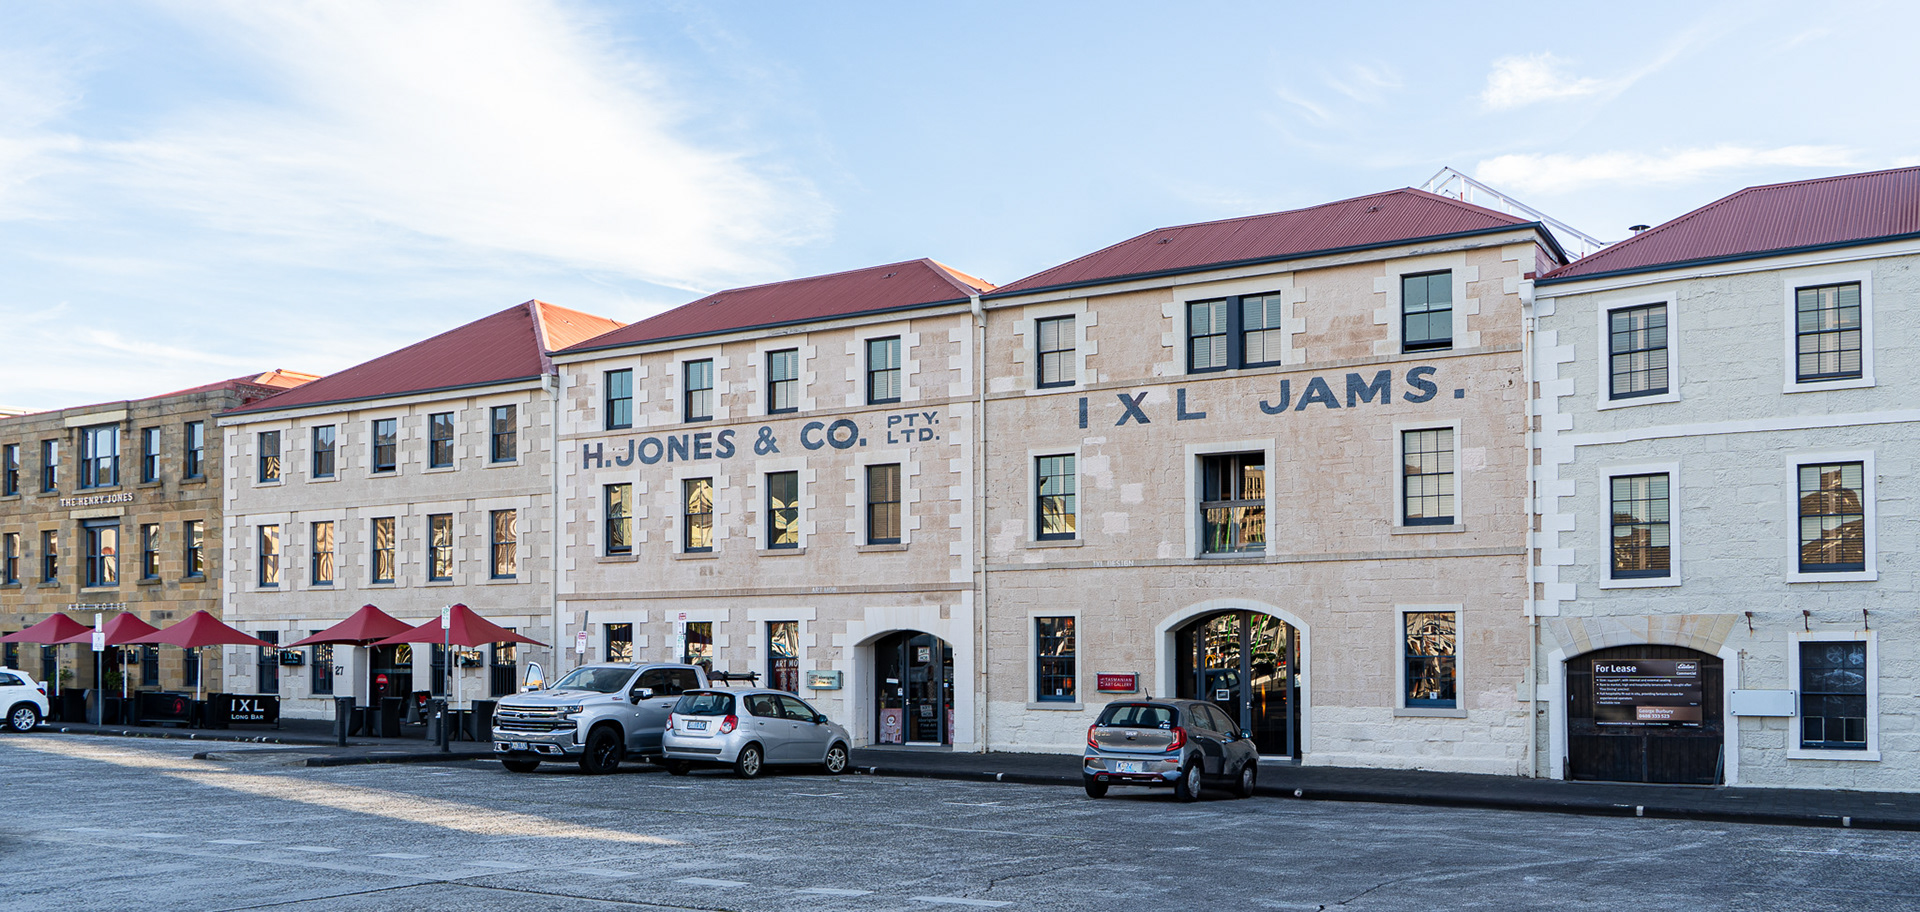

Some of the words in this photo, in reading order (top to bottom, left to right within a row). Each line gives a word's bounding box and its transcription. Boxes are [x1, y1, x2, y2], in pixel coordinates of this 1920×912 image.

[1259, 366, 1465, 414] JAMS.
[888, 411, 939, 429] PTY.
[754, 425, 781, 456] &
[800, 418, 866, 451] CO.
[887, 427, 940, 444] LTD.
[60, 498, 76, 507] THE
[78, 495, 104, 506] HENRY
[107, 493, 134, 503] JONES
[68, 603, 87, 611] ART
[775, 659, 787, 668] ART
[788, 659, 799, 668] MO
[1595, 664, 1610, 673] For
[1611, 664, 1637, 673] Lease
[335, 666, 344, 676] 27
[231, 699, 265, 712] IXL
